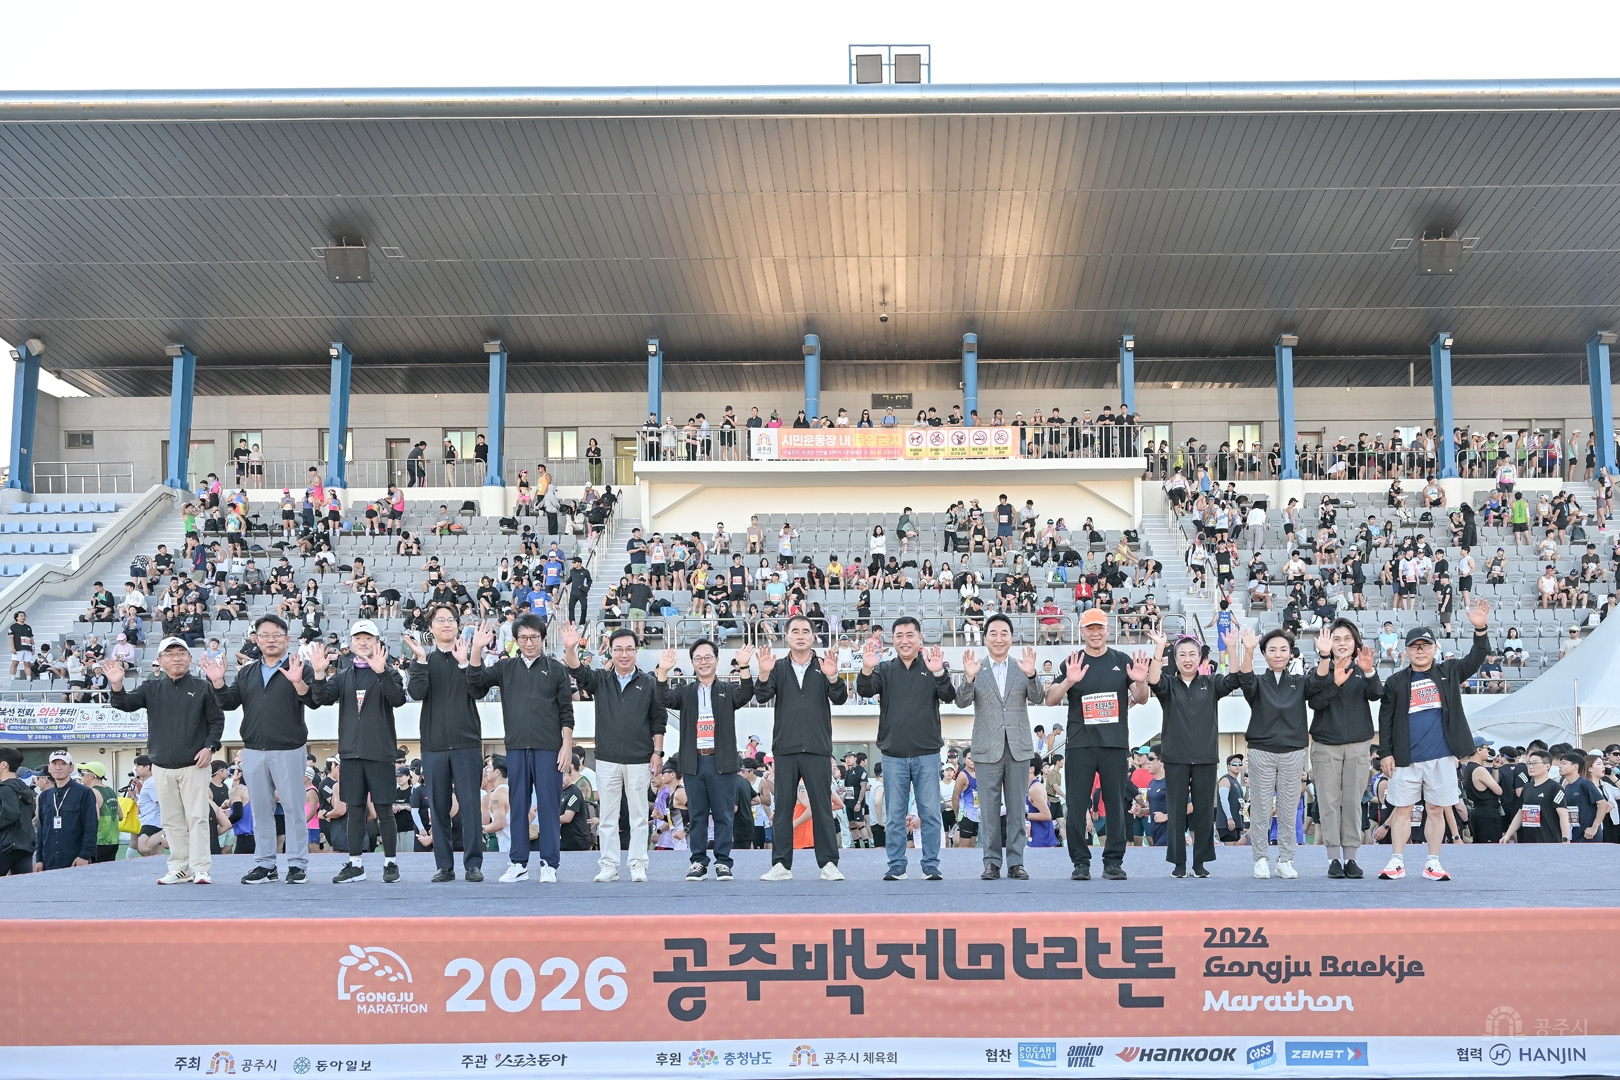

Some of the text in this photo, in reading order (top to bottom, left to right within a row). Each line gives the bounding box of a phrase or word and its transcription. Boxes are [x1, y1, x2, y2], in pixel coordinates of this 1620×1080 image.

[782, 434, 837, 447] 시민운동장
[839, 434, 850, 446] 내
[17, 708, 35, 717] 전화,
[37, 707, 77, 716] 의심부터!
[1203, 927, 1269, 948] 2026
[444, 926, 1176, 1022] 2026 공주백제마라톤
[1203, 955, 1424, 984] Gongju Baekje
[356, 992, 414, 1002] GONGJU
[1202, 990, 1354, 1012] Marathon
[357, 1003, 428, 1014] MARATHON
[985, 1048, 1012, 1063] 협찬
[1067, 1042, 1104, 1056] amino
[1456, 1048, 1482, 1062] 협력
[1519, 1048, 1586, 1064] HANJIN
[174, 1056, 200, 1071] 주최
[241, 1058, 277, 1072] 공주시
[461, 1054, 488, 1068] 주관
[495, 1053, 568, 1068] 스포츠동아
[656, 1052, 682, 1066] 후원
[723, 1051, 772, 1066] 충청남도
[823, 1052, 898, 1064] 공주시 체육회
[1067, 1056, 1095, 1068] VITAL
[1258, 1058, 1272, 1068] LIGHT
[315, 1060, 372, 1072] 동아일보
